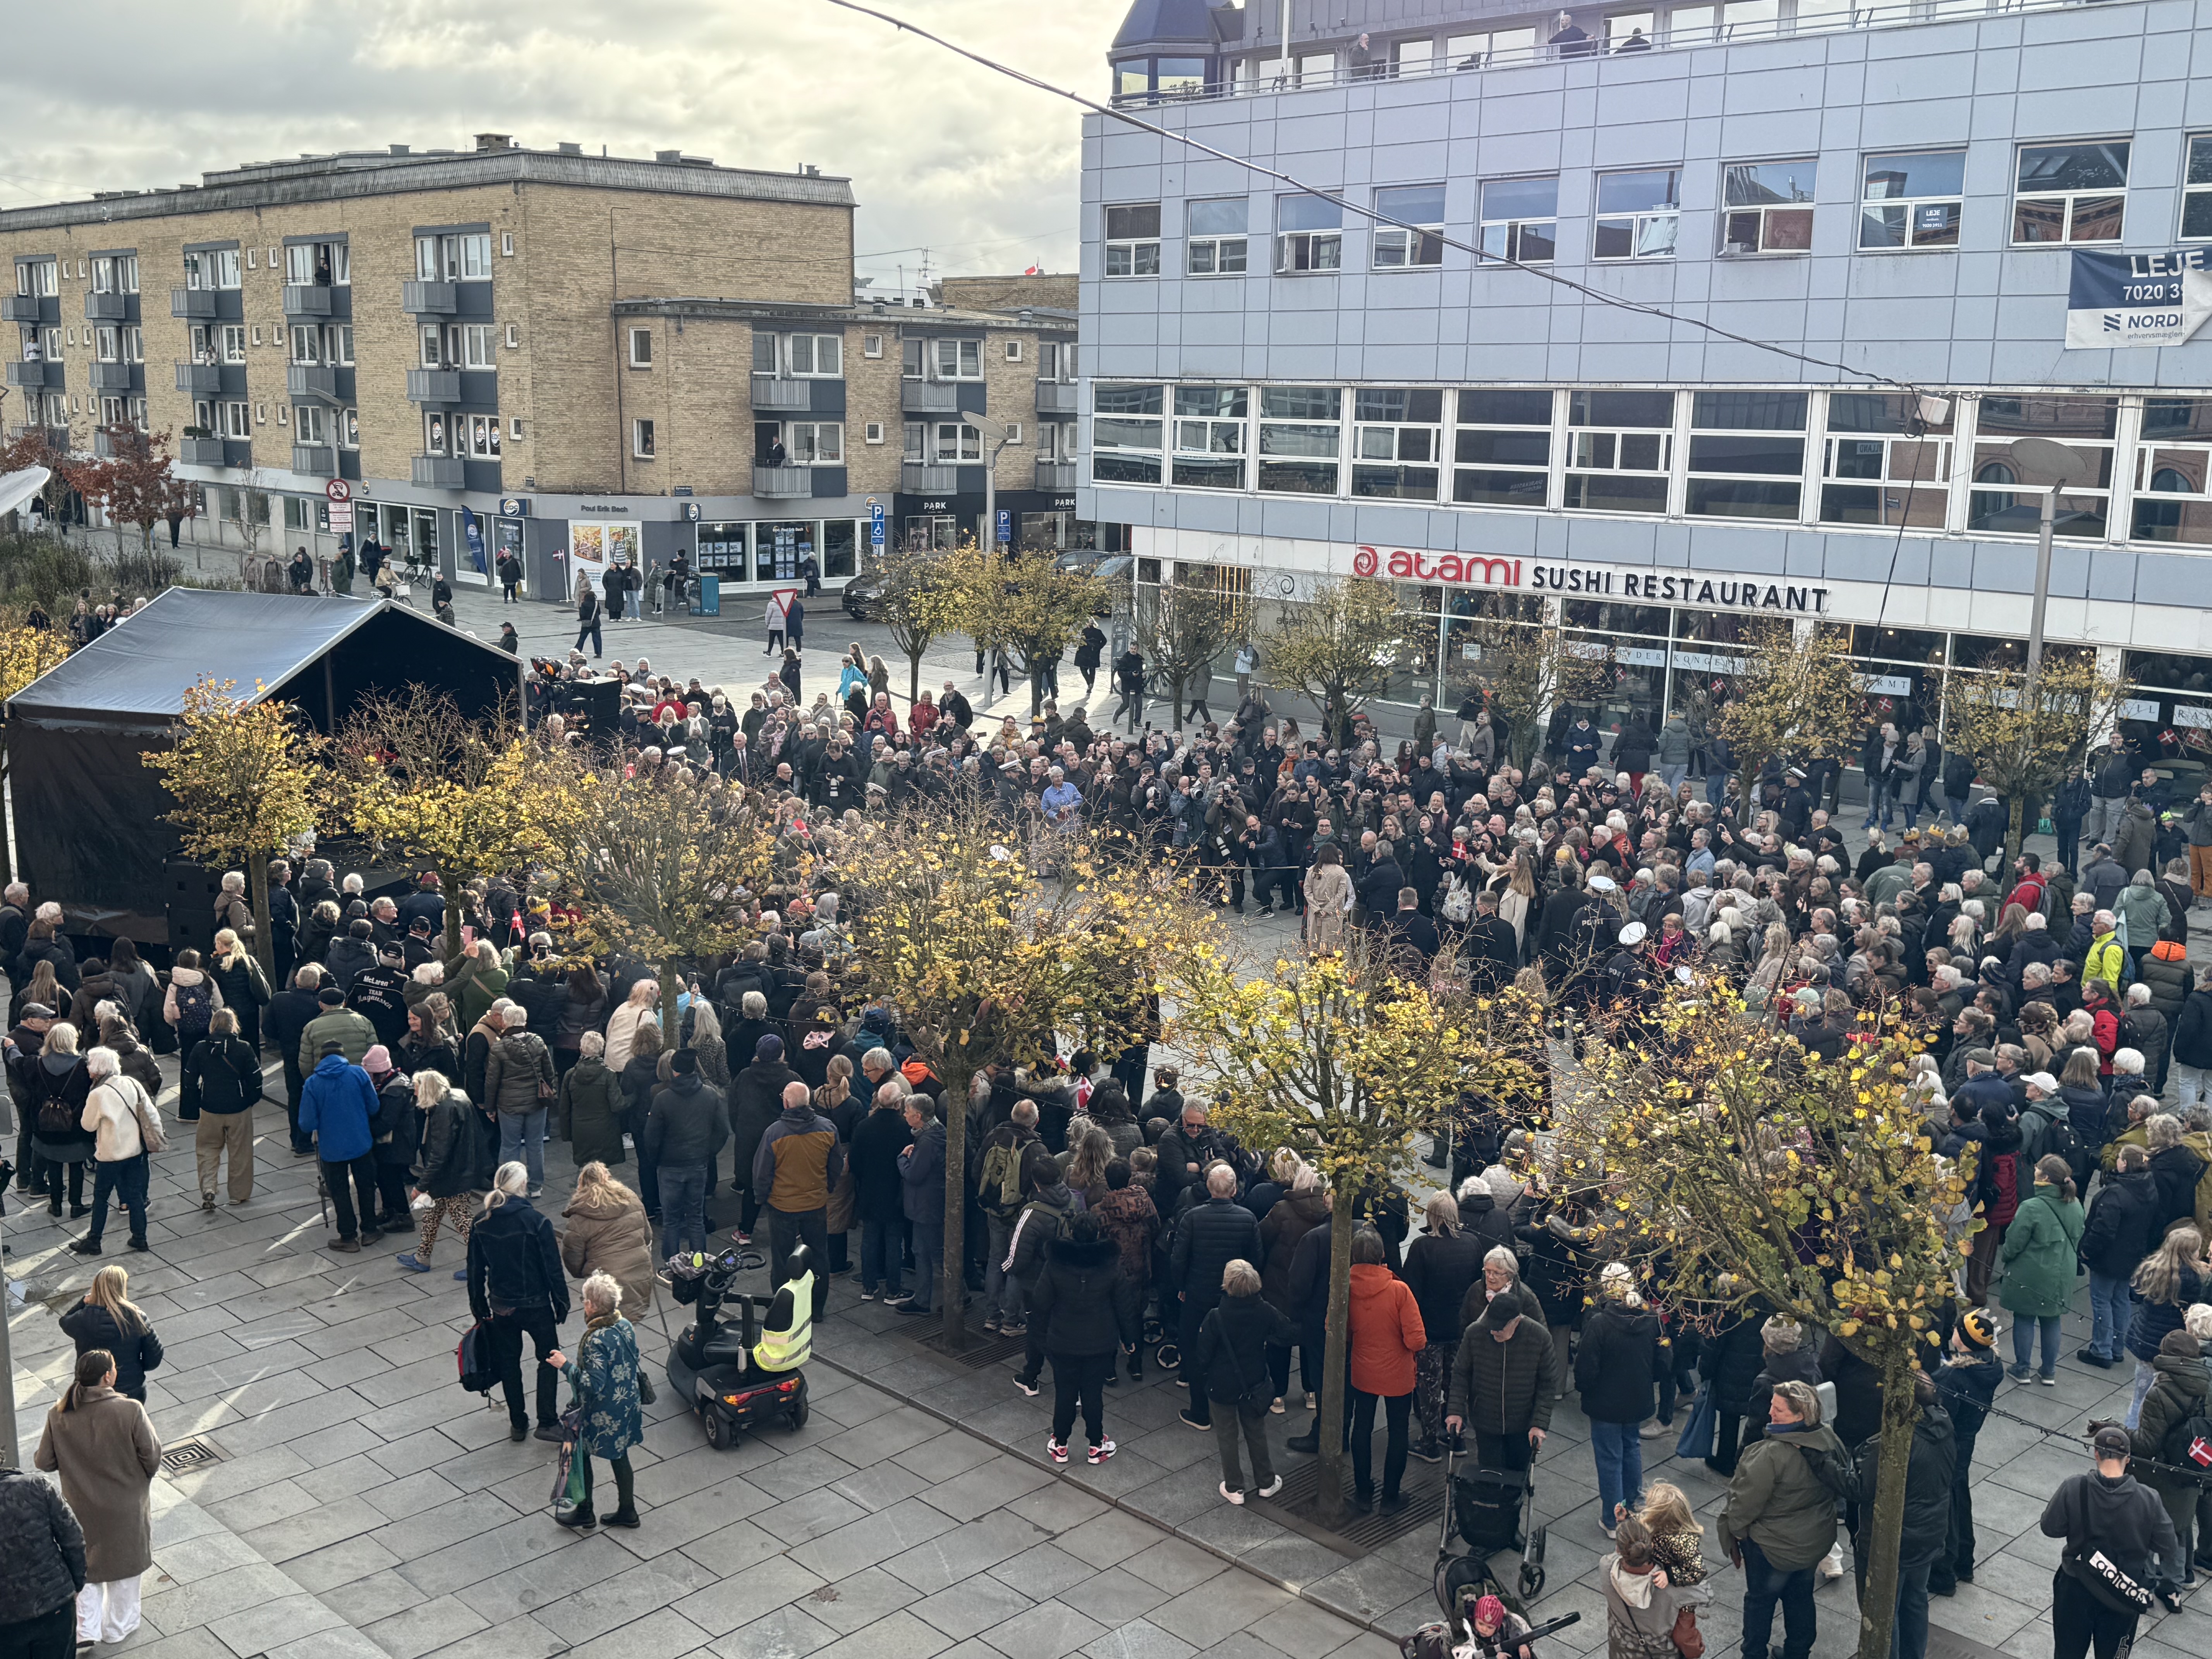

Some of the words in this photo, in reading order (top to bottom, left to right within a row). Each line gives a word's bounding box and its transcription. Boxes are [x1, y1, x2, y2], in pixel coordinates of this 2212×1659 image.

[2131, 251, 2204, 278] LEJE
[2123, 285, 2163, 301] 7020
[874, 507, 882, 519] P
[1001, 512, 1008, 524] P
[1388, 550, 1520, 586] atami
[1532, 566, 1611, 594] SUSHI
[1624, 574, 1827, 612] RESTAURANT
[363, 975, 388, 986] McLaren
[2096, 1560, 2150, 1604] adidas
